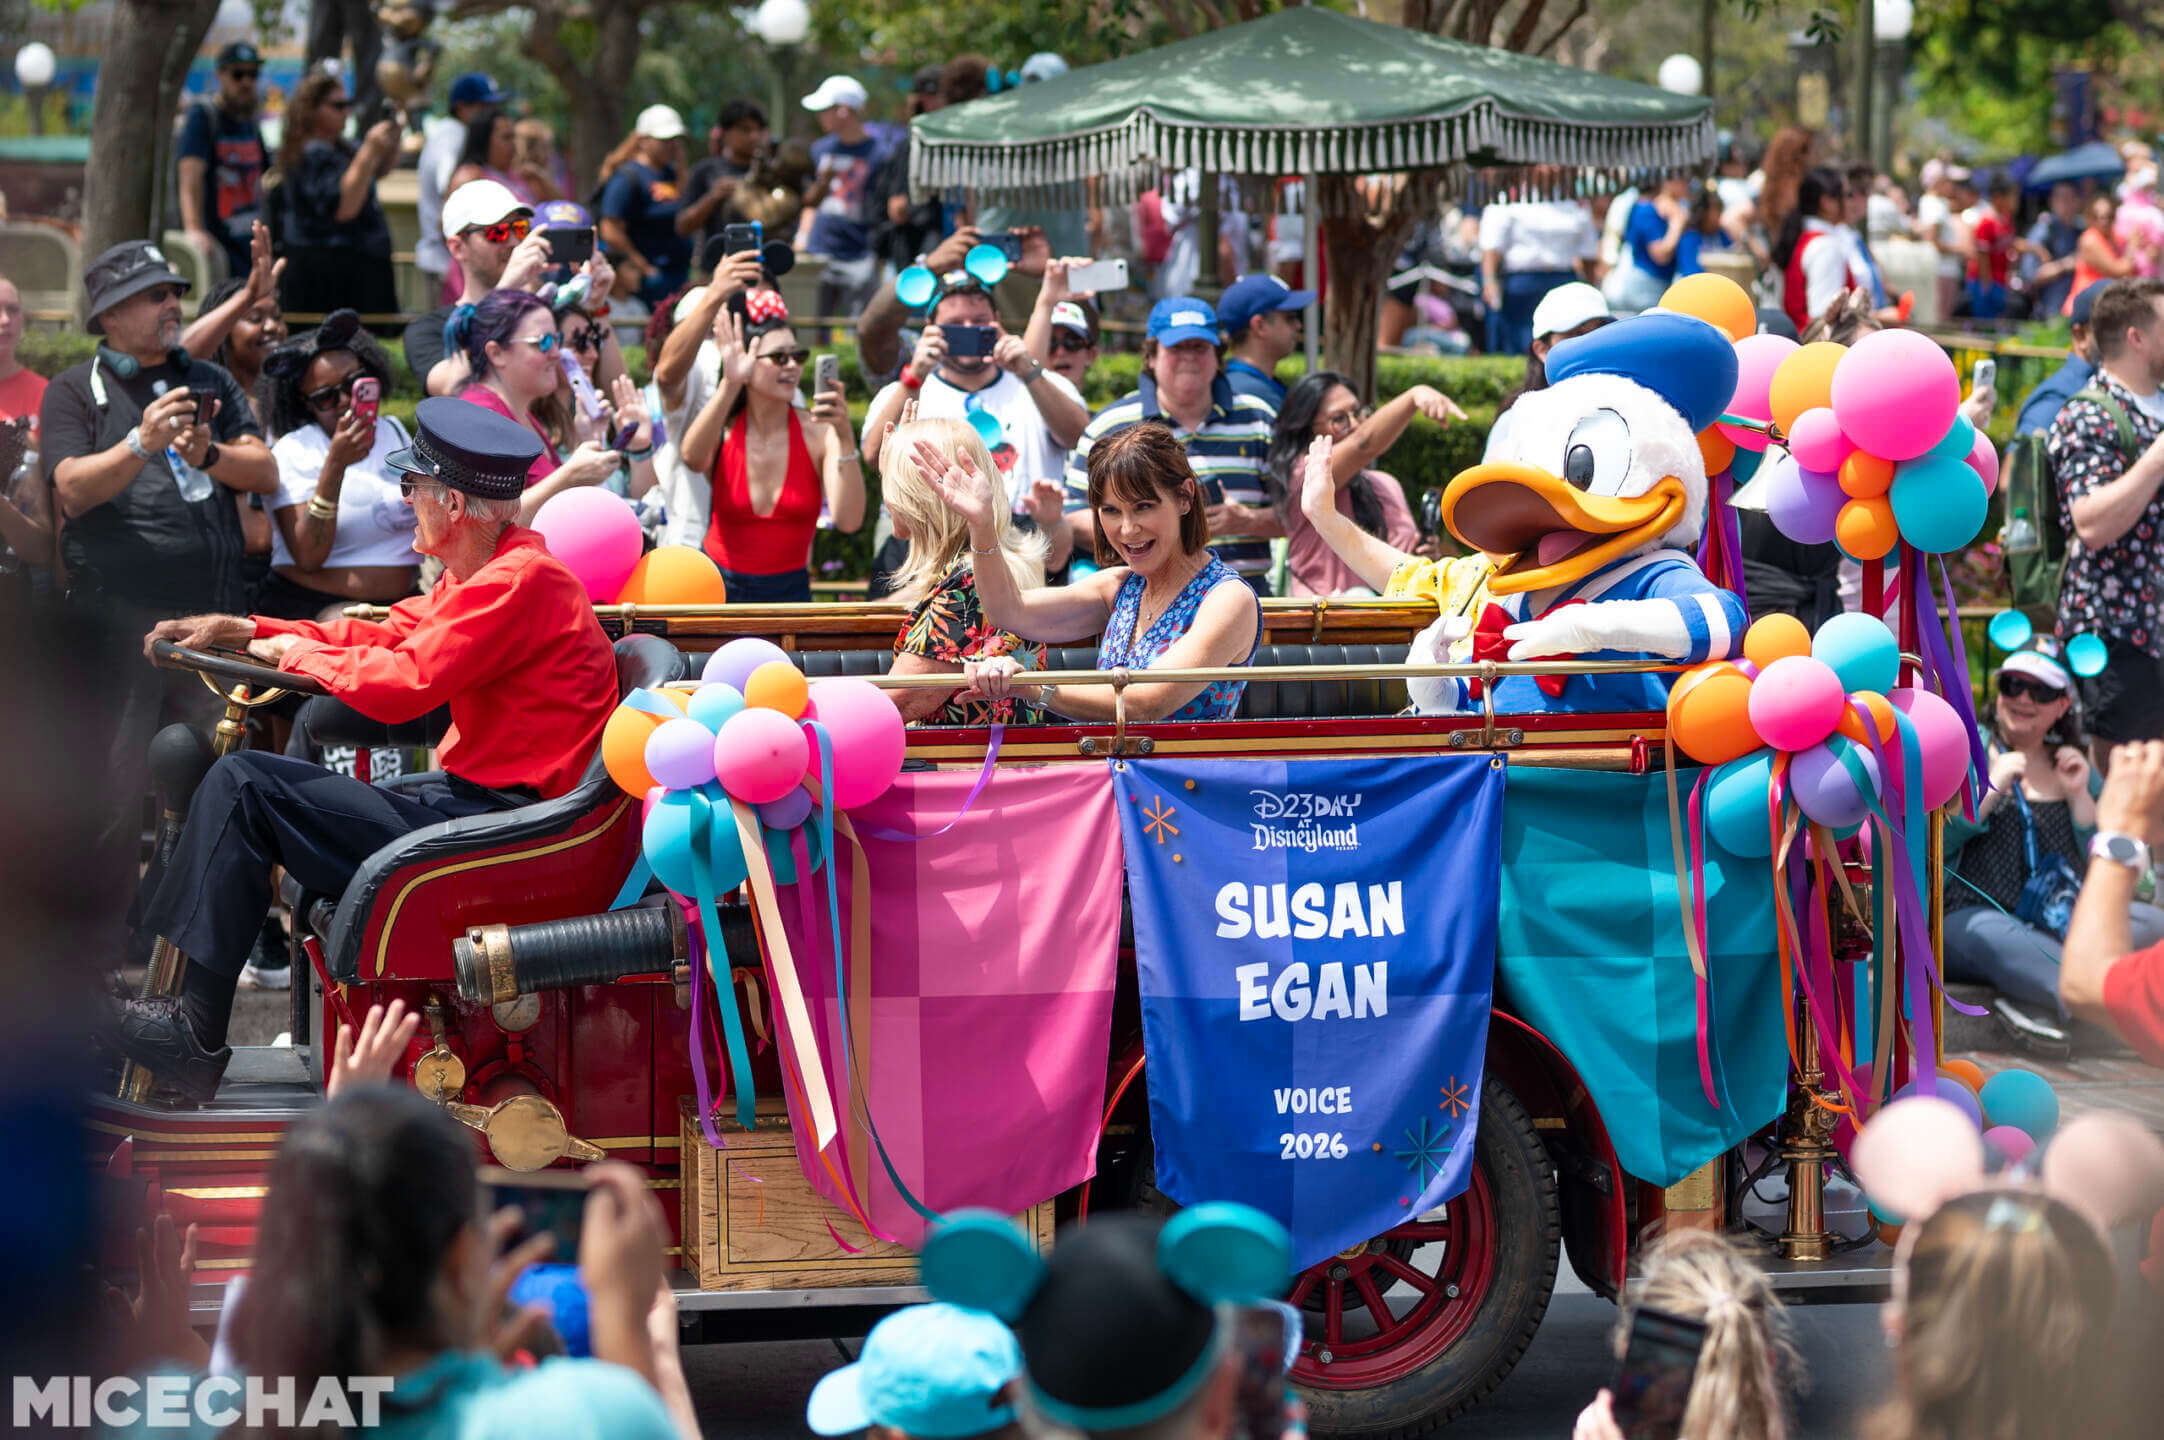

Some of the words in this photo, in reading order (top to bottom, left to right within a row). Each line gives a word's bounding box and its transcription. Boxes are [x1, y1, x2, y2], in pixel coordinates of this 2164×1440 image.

[1314, 793, 1362, 817] DAY
[1249, 822, 1359, 853] Disneyland
[1297, 818, 1313, 829] AT
[1214, 881, 1406, 939] SUSAN
[1235, 960, 1388, 1022] EGAN
[1273, 1086, 1353, 1115] VOICE
[1279, 1132, 1349, 1160] 2026
